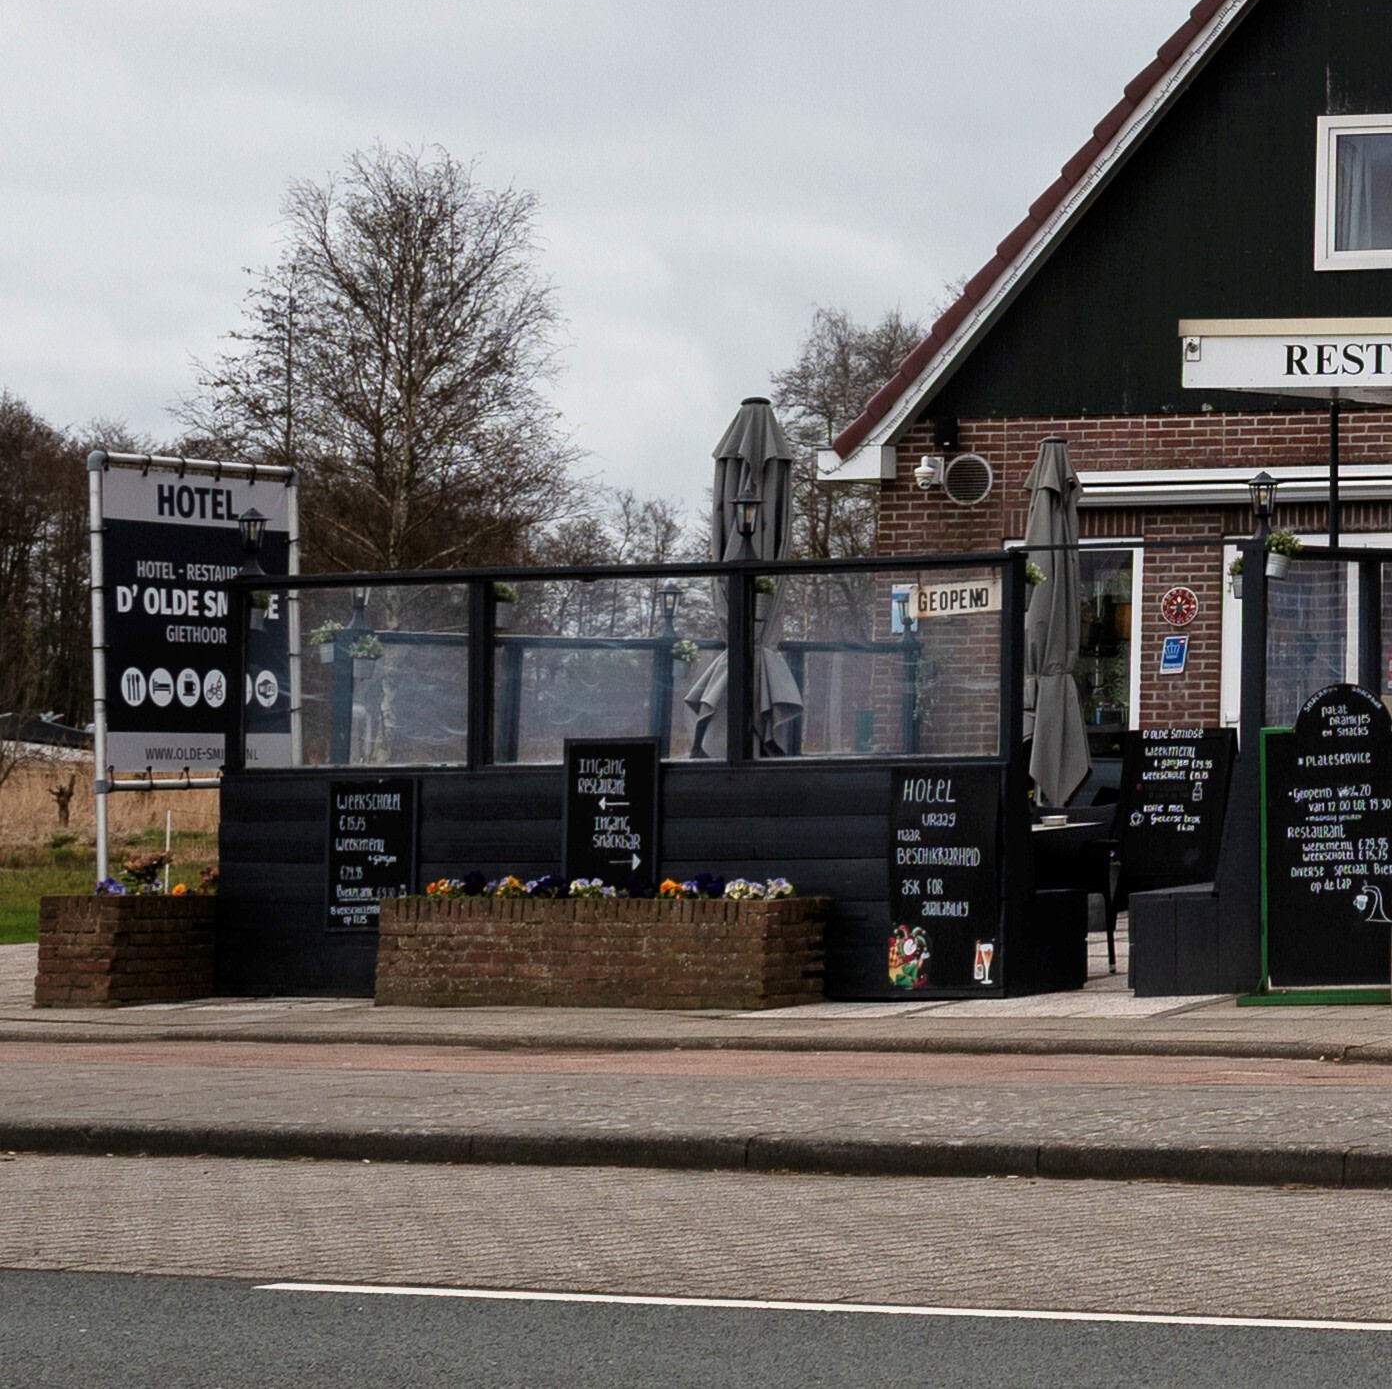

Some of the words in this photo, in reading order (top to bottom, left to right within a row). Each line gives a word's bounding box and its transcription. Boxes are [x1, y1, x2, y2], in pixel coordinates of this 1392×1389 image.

[157, 483, 240, 521] HOTEL
[137, 560, 176, 580] HOTEL
[187, 563, 243, 582] RESTAUR
[143, 586, 199, 616] OLDE
[918, 587, 989, 612] GEOPEND
[166, 624, 228, 644] GIETHOOR
